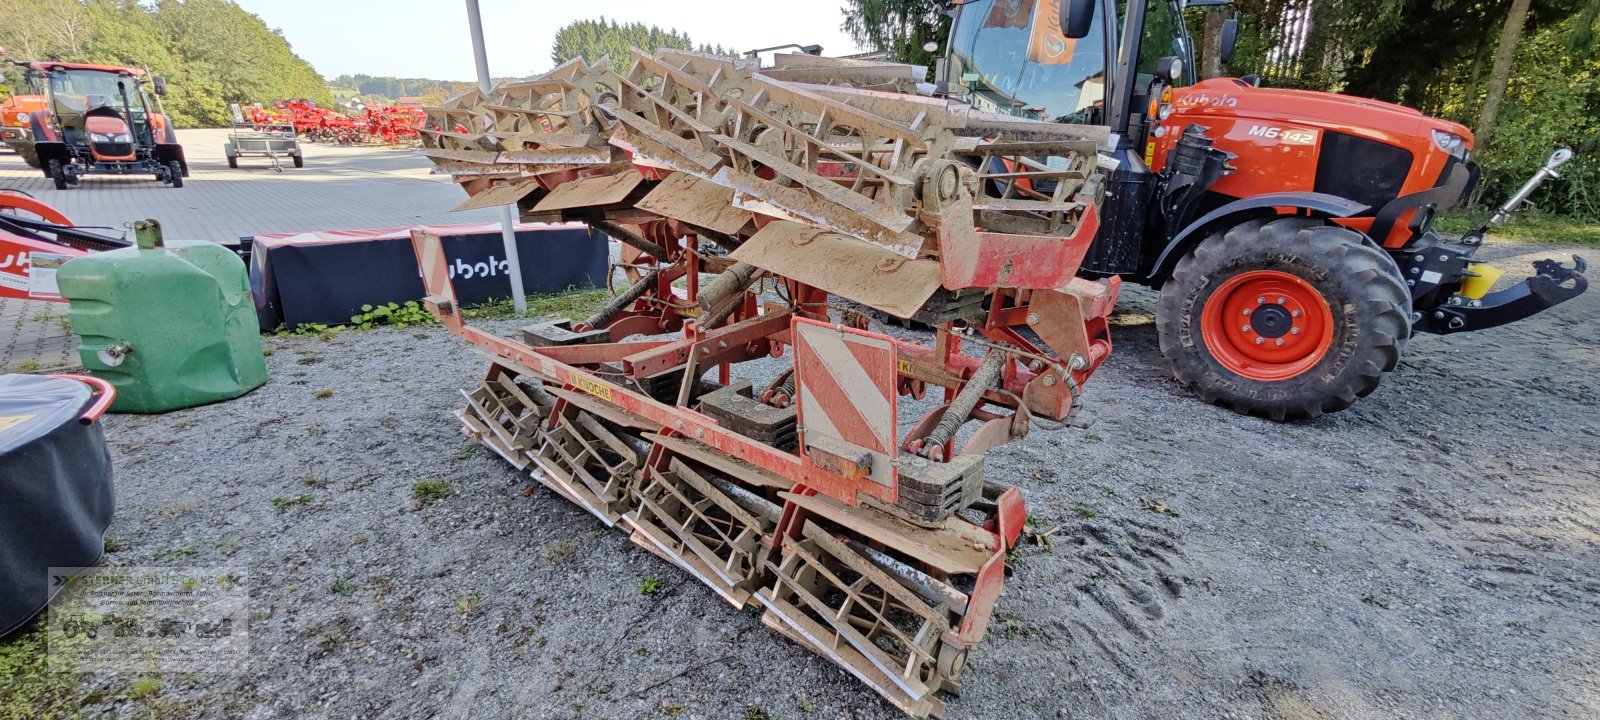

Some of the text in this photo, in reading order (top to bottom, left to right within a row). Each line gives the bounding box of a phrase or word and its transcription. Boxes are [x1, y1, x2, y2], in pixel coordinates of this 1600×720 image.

[1176, 94, 1238, 107] Kubota
[1249, 125, 1313, 143] M6-142
[578, 377, 609, 399] KNOCHE
